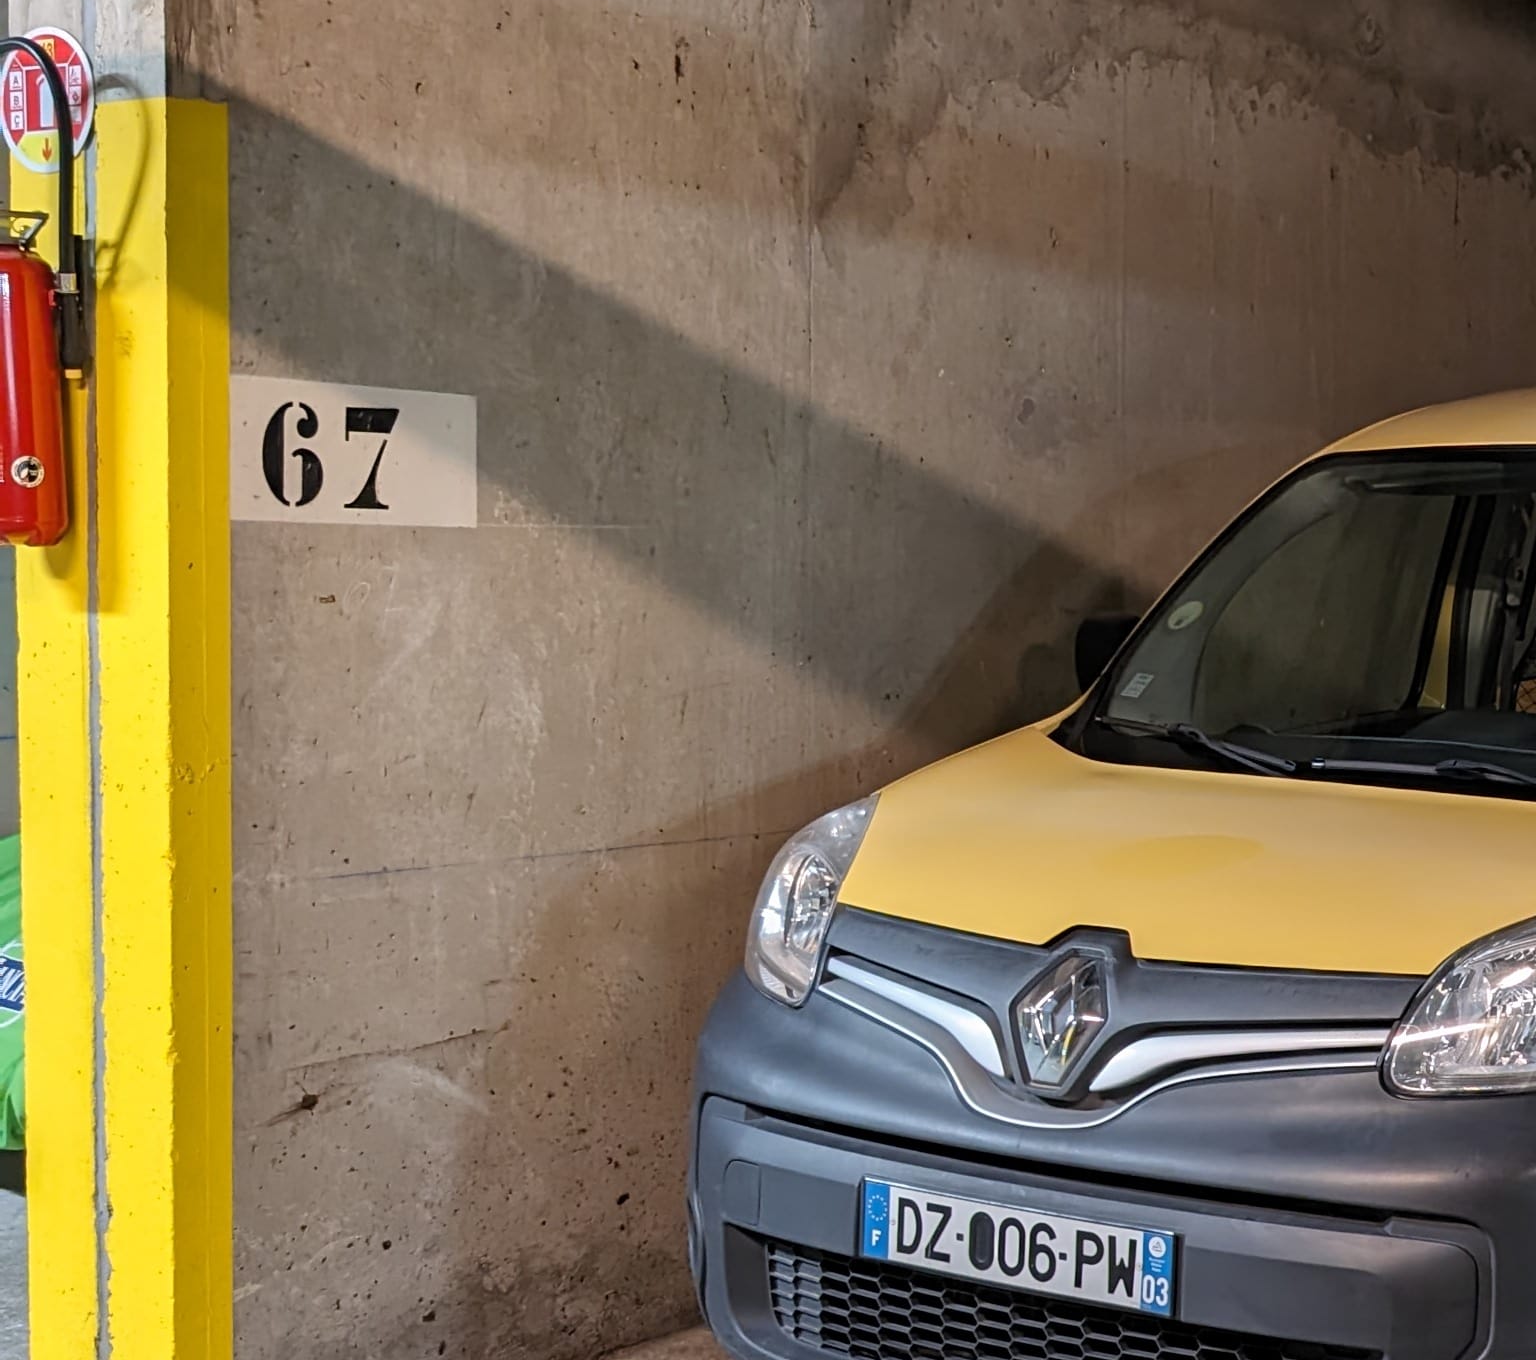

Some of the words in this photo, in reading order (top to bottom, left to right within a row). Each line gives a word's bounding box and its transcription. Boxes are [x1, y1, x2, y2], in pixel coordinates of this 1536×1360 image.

[262, 401, 400, 510] 67
[871, 1229, 882, 1247] F
[1142, 1274, 1169, 1307] 03
